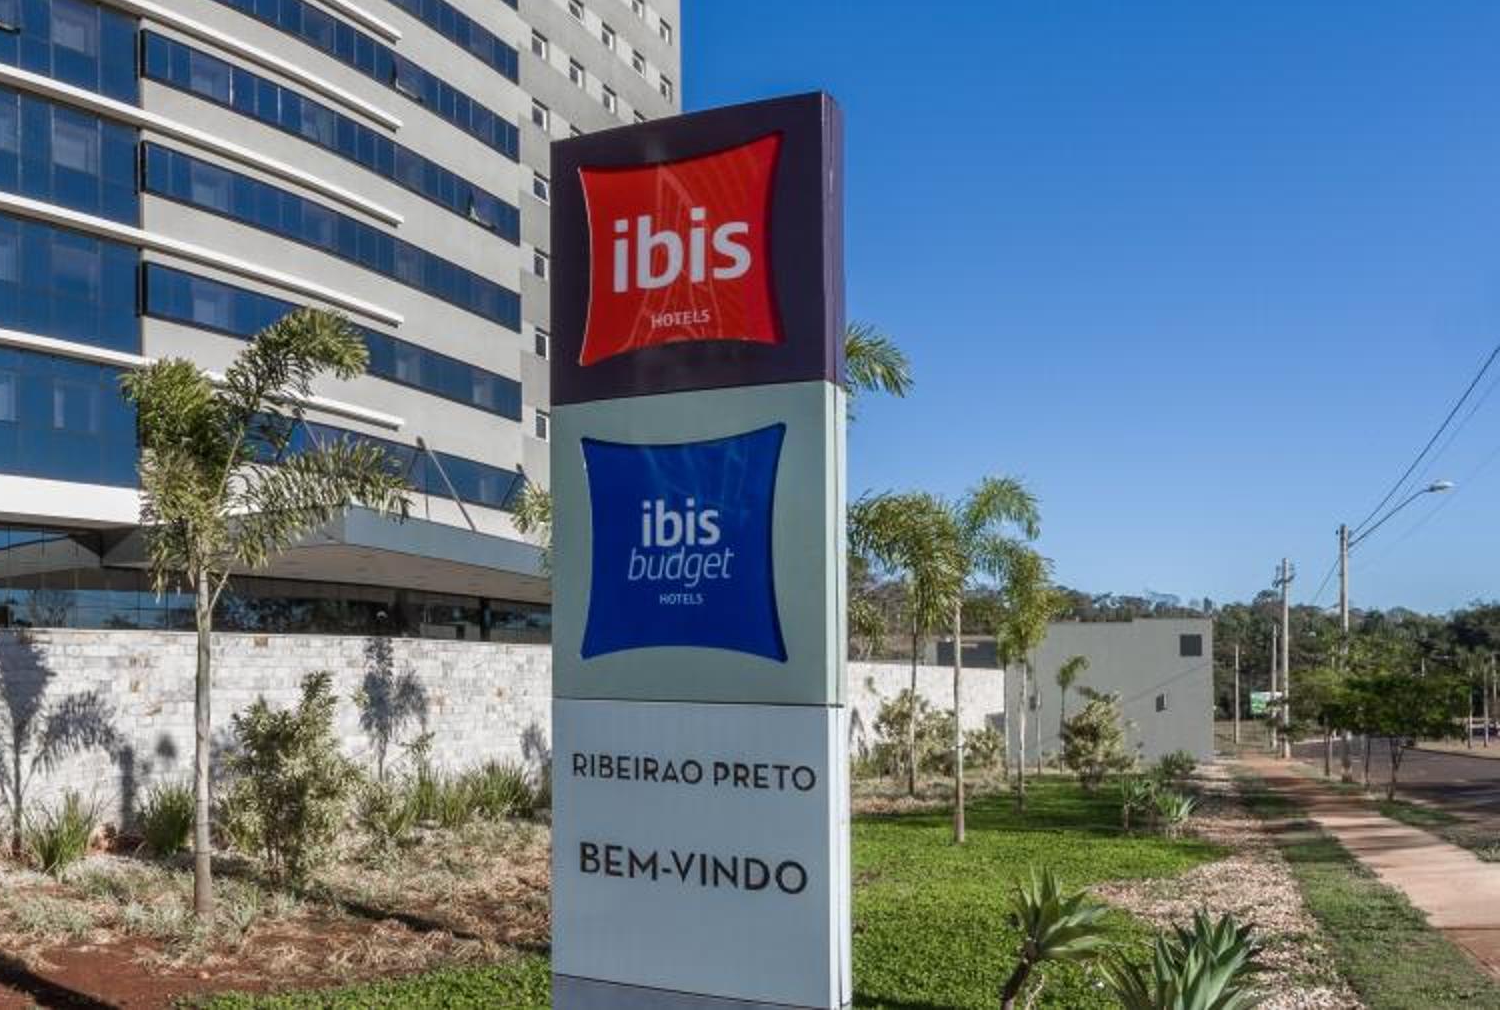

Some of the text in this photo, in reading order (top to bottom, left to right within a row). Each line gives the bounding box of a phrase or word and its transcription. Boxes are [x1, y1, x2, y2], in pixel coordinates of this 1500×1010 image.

[613, 207, 751, 293] ibis
[650, 309, 711, 329] HOTELS
[642, 497, 721, 547] ibis
[627, 546, 735, 588] budget
[659, 593, 704, 605] HOTELS
[572, 753, 817, 792] RIBEIRAO PRETO
[579, 841, 808, 895] BEM-VINDO
